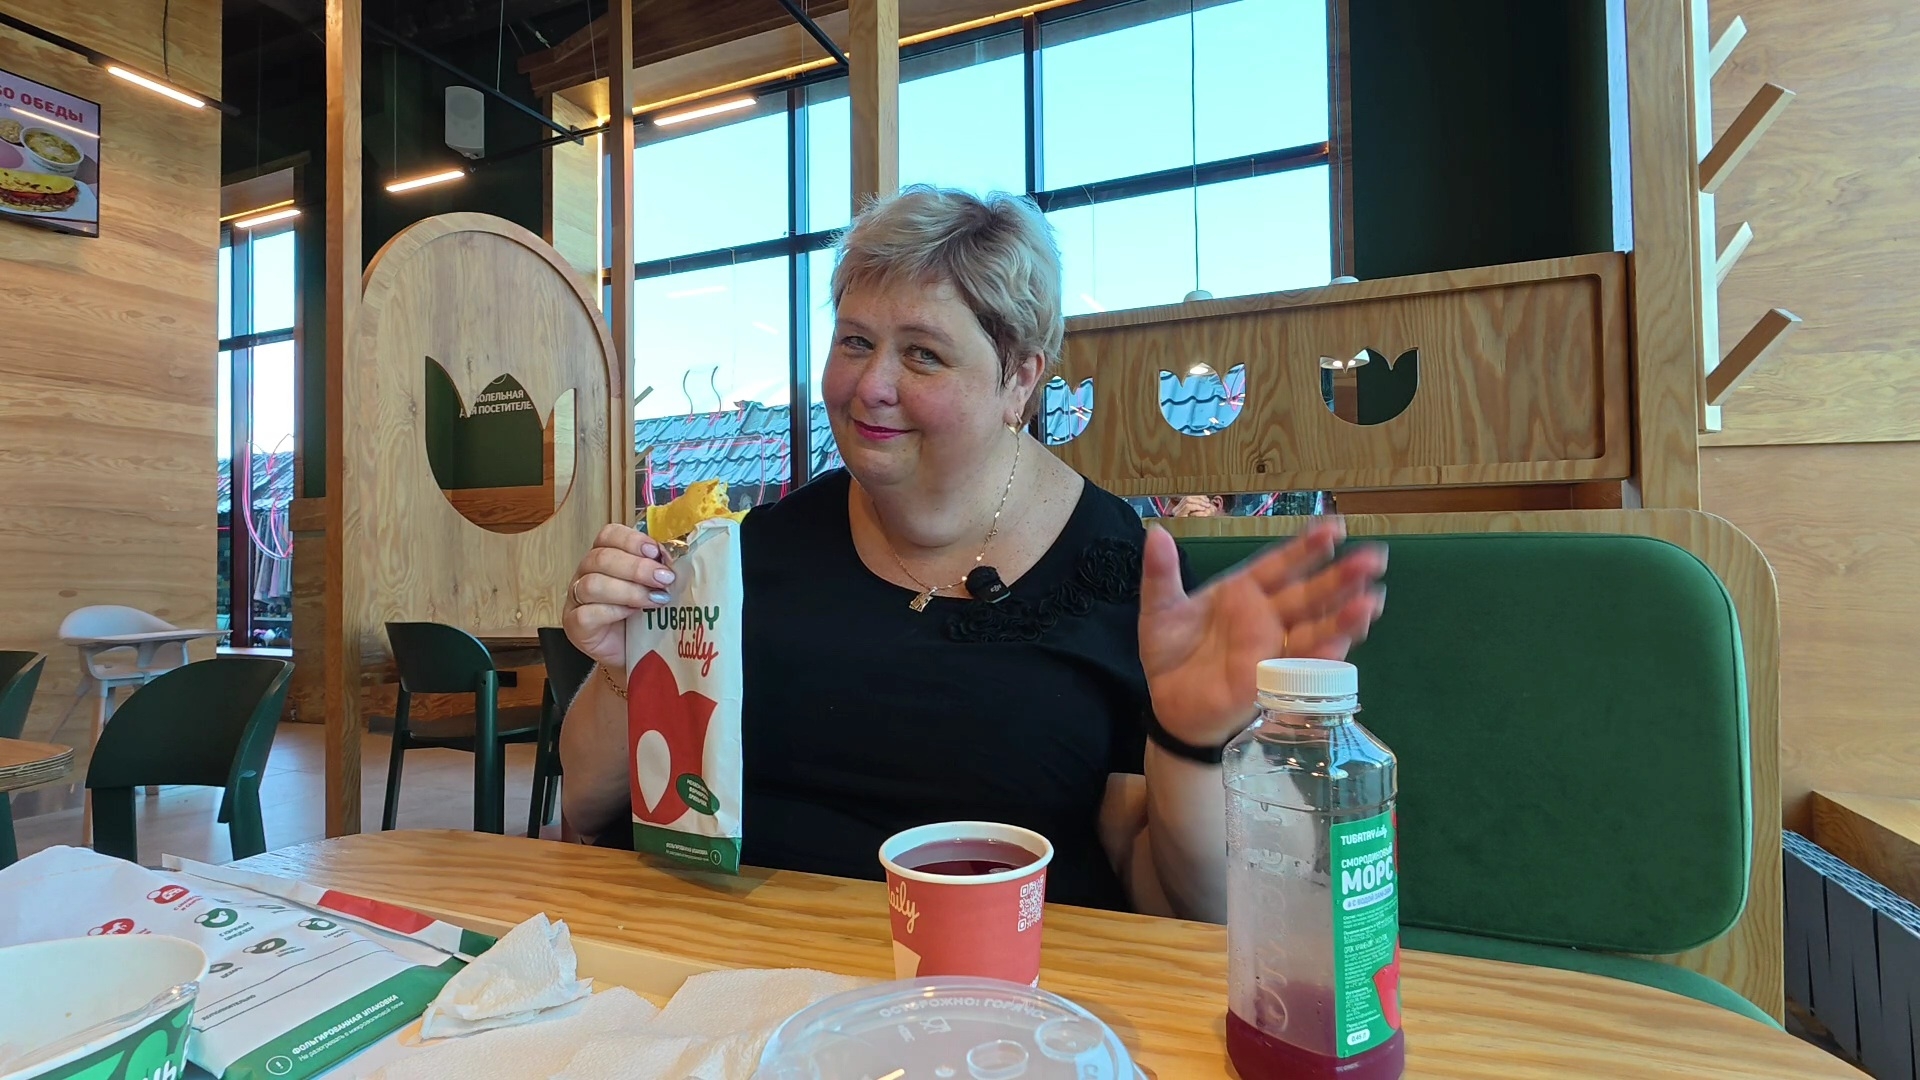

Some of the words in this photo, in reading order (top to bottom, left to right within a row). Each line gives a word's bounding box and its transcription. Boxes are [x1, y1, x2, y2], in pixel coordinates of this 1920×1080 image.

[21, 93, 83, 123] ОБЕДЫ
[478, 401, 534, 415] ПОСЕТИТЕЛЕ
[643, 605, 720, 631] TUBATAY
[678, 622, 719, 678] daily
[1341, 829, 1376, 846] TUBATAY
[1341, 855, 1394, 896] МОРС
[292, 1013, 363, 1055] ФОЛЬГИРОВАННАЯ
[361, 994, 399, 1017] УПАКОВКА
